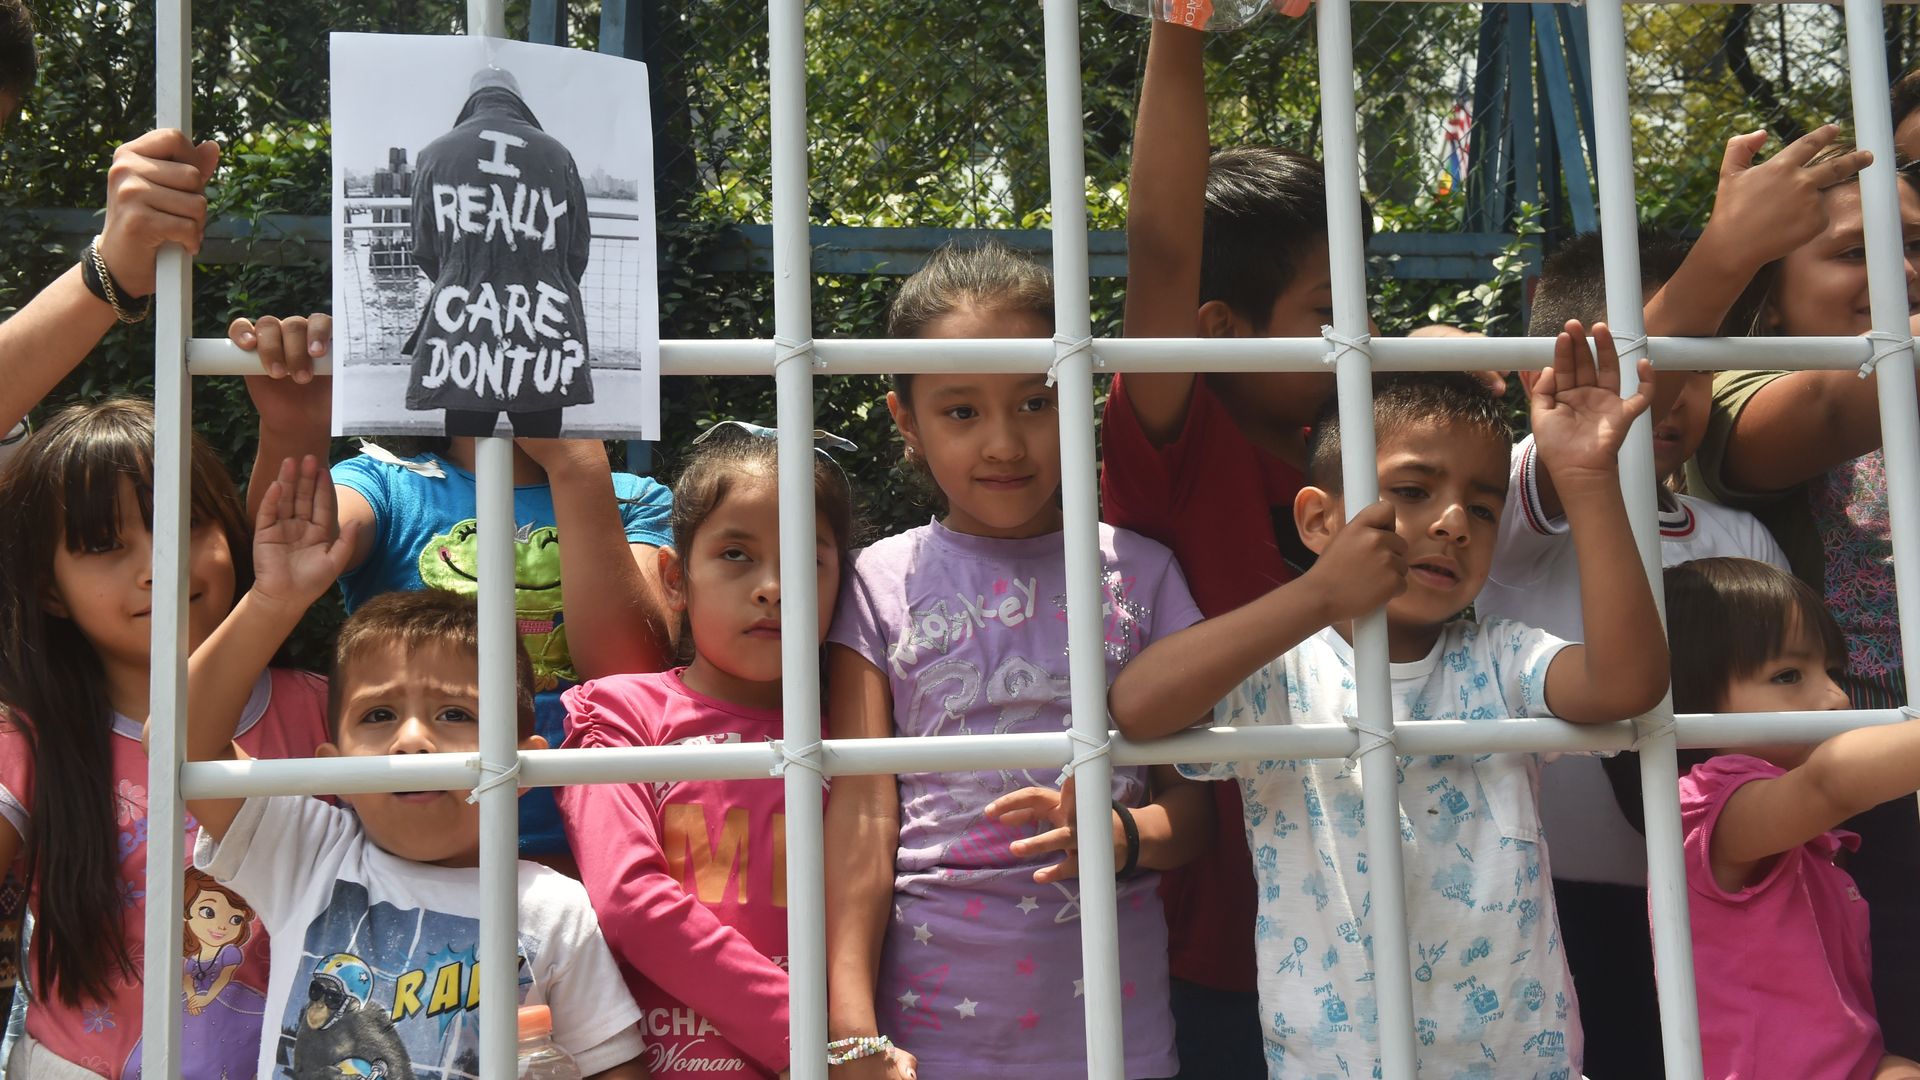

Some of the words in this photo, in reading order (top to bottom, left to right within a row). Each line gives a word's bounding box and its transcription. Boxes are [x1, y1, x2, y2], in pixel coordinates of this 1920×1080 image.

[478, 130, 528, 178] I
[432, 182, 568, 252] REALLY
[646, 1038, 745, 1073] Woman
